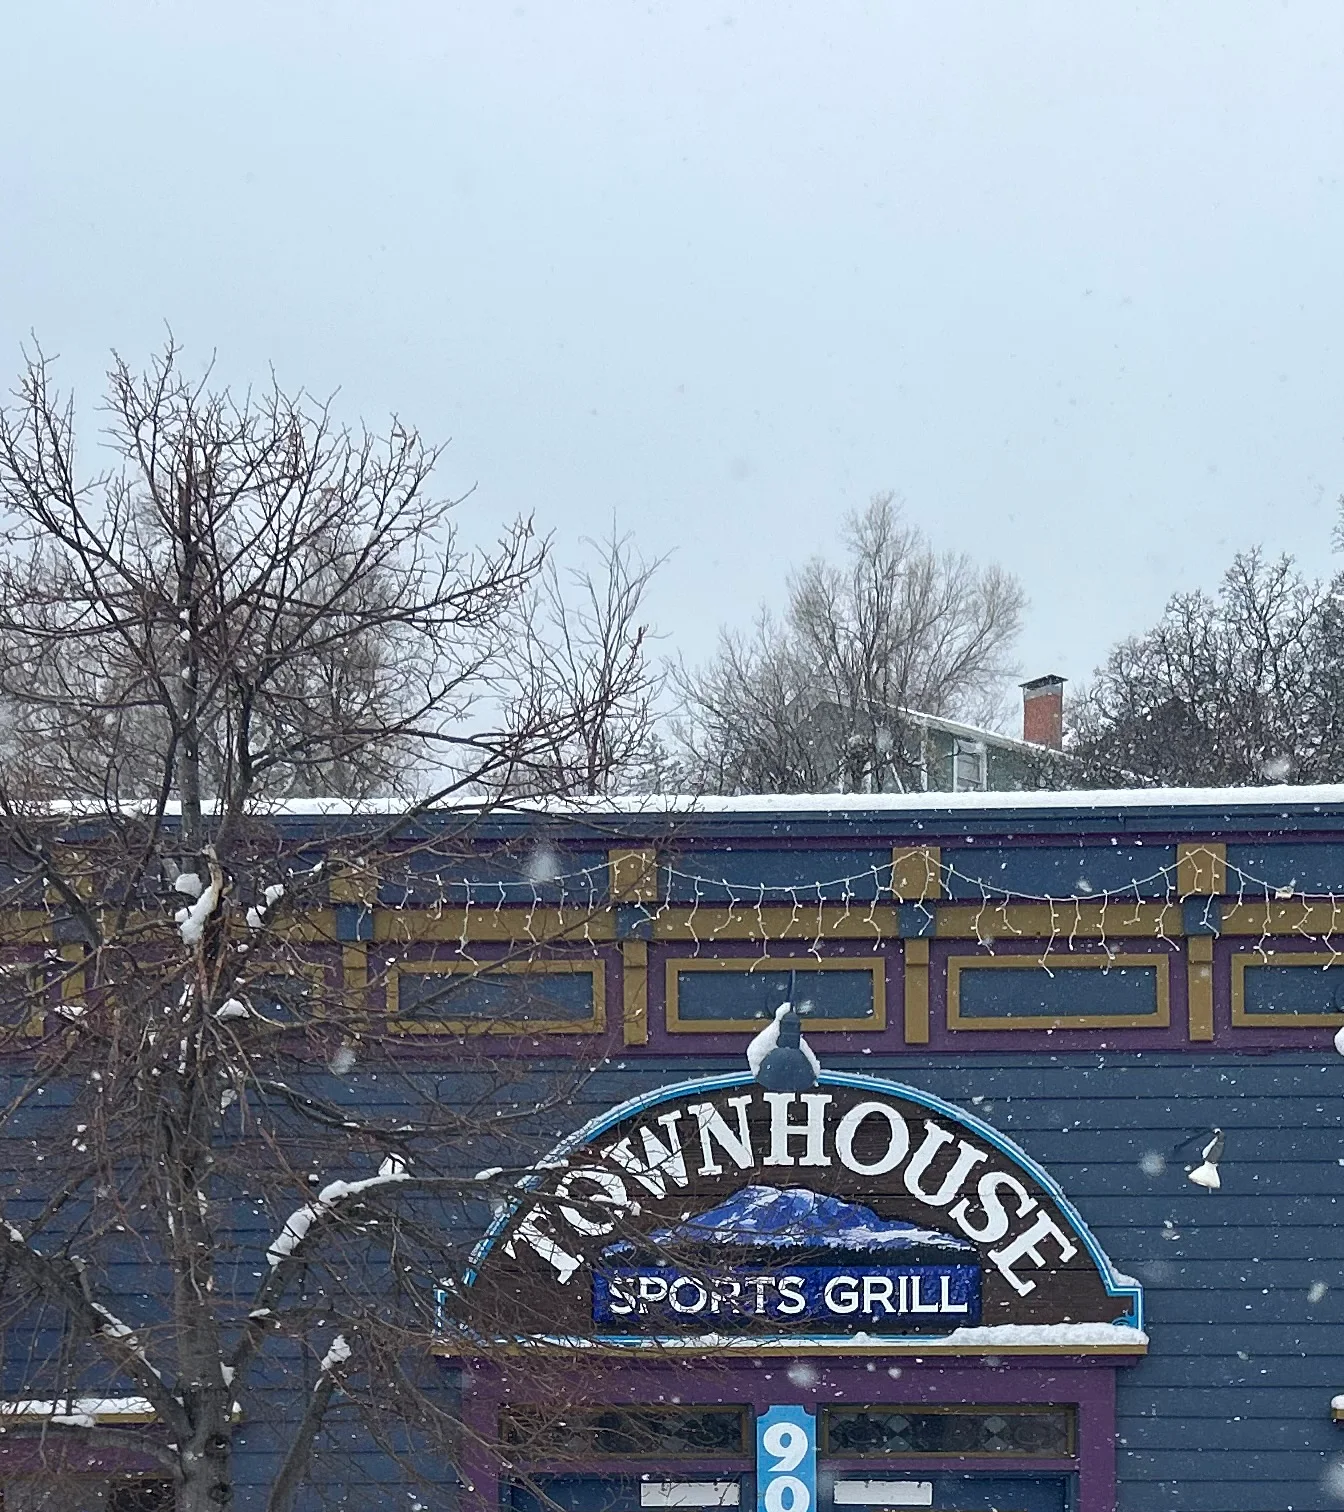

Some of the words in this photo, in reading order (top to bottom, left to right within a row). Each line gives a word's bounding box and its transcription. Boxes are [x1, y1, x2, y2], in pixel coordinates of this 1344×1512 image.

[504, 1092, 1077, 1297] TOWNHOUSE
[608, 1275, 805, 1315] SPORTS
[823, 1275, 968, 1314] GRILL
